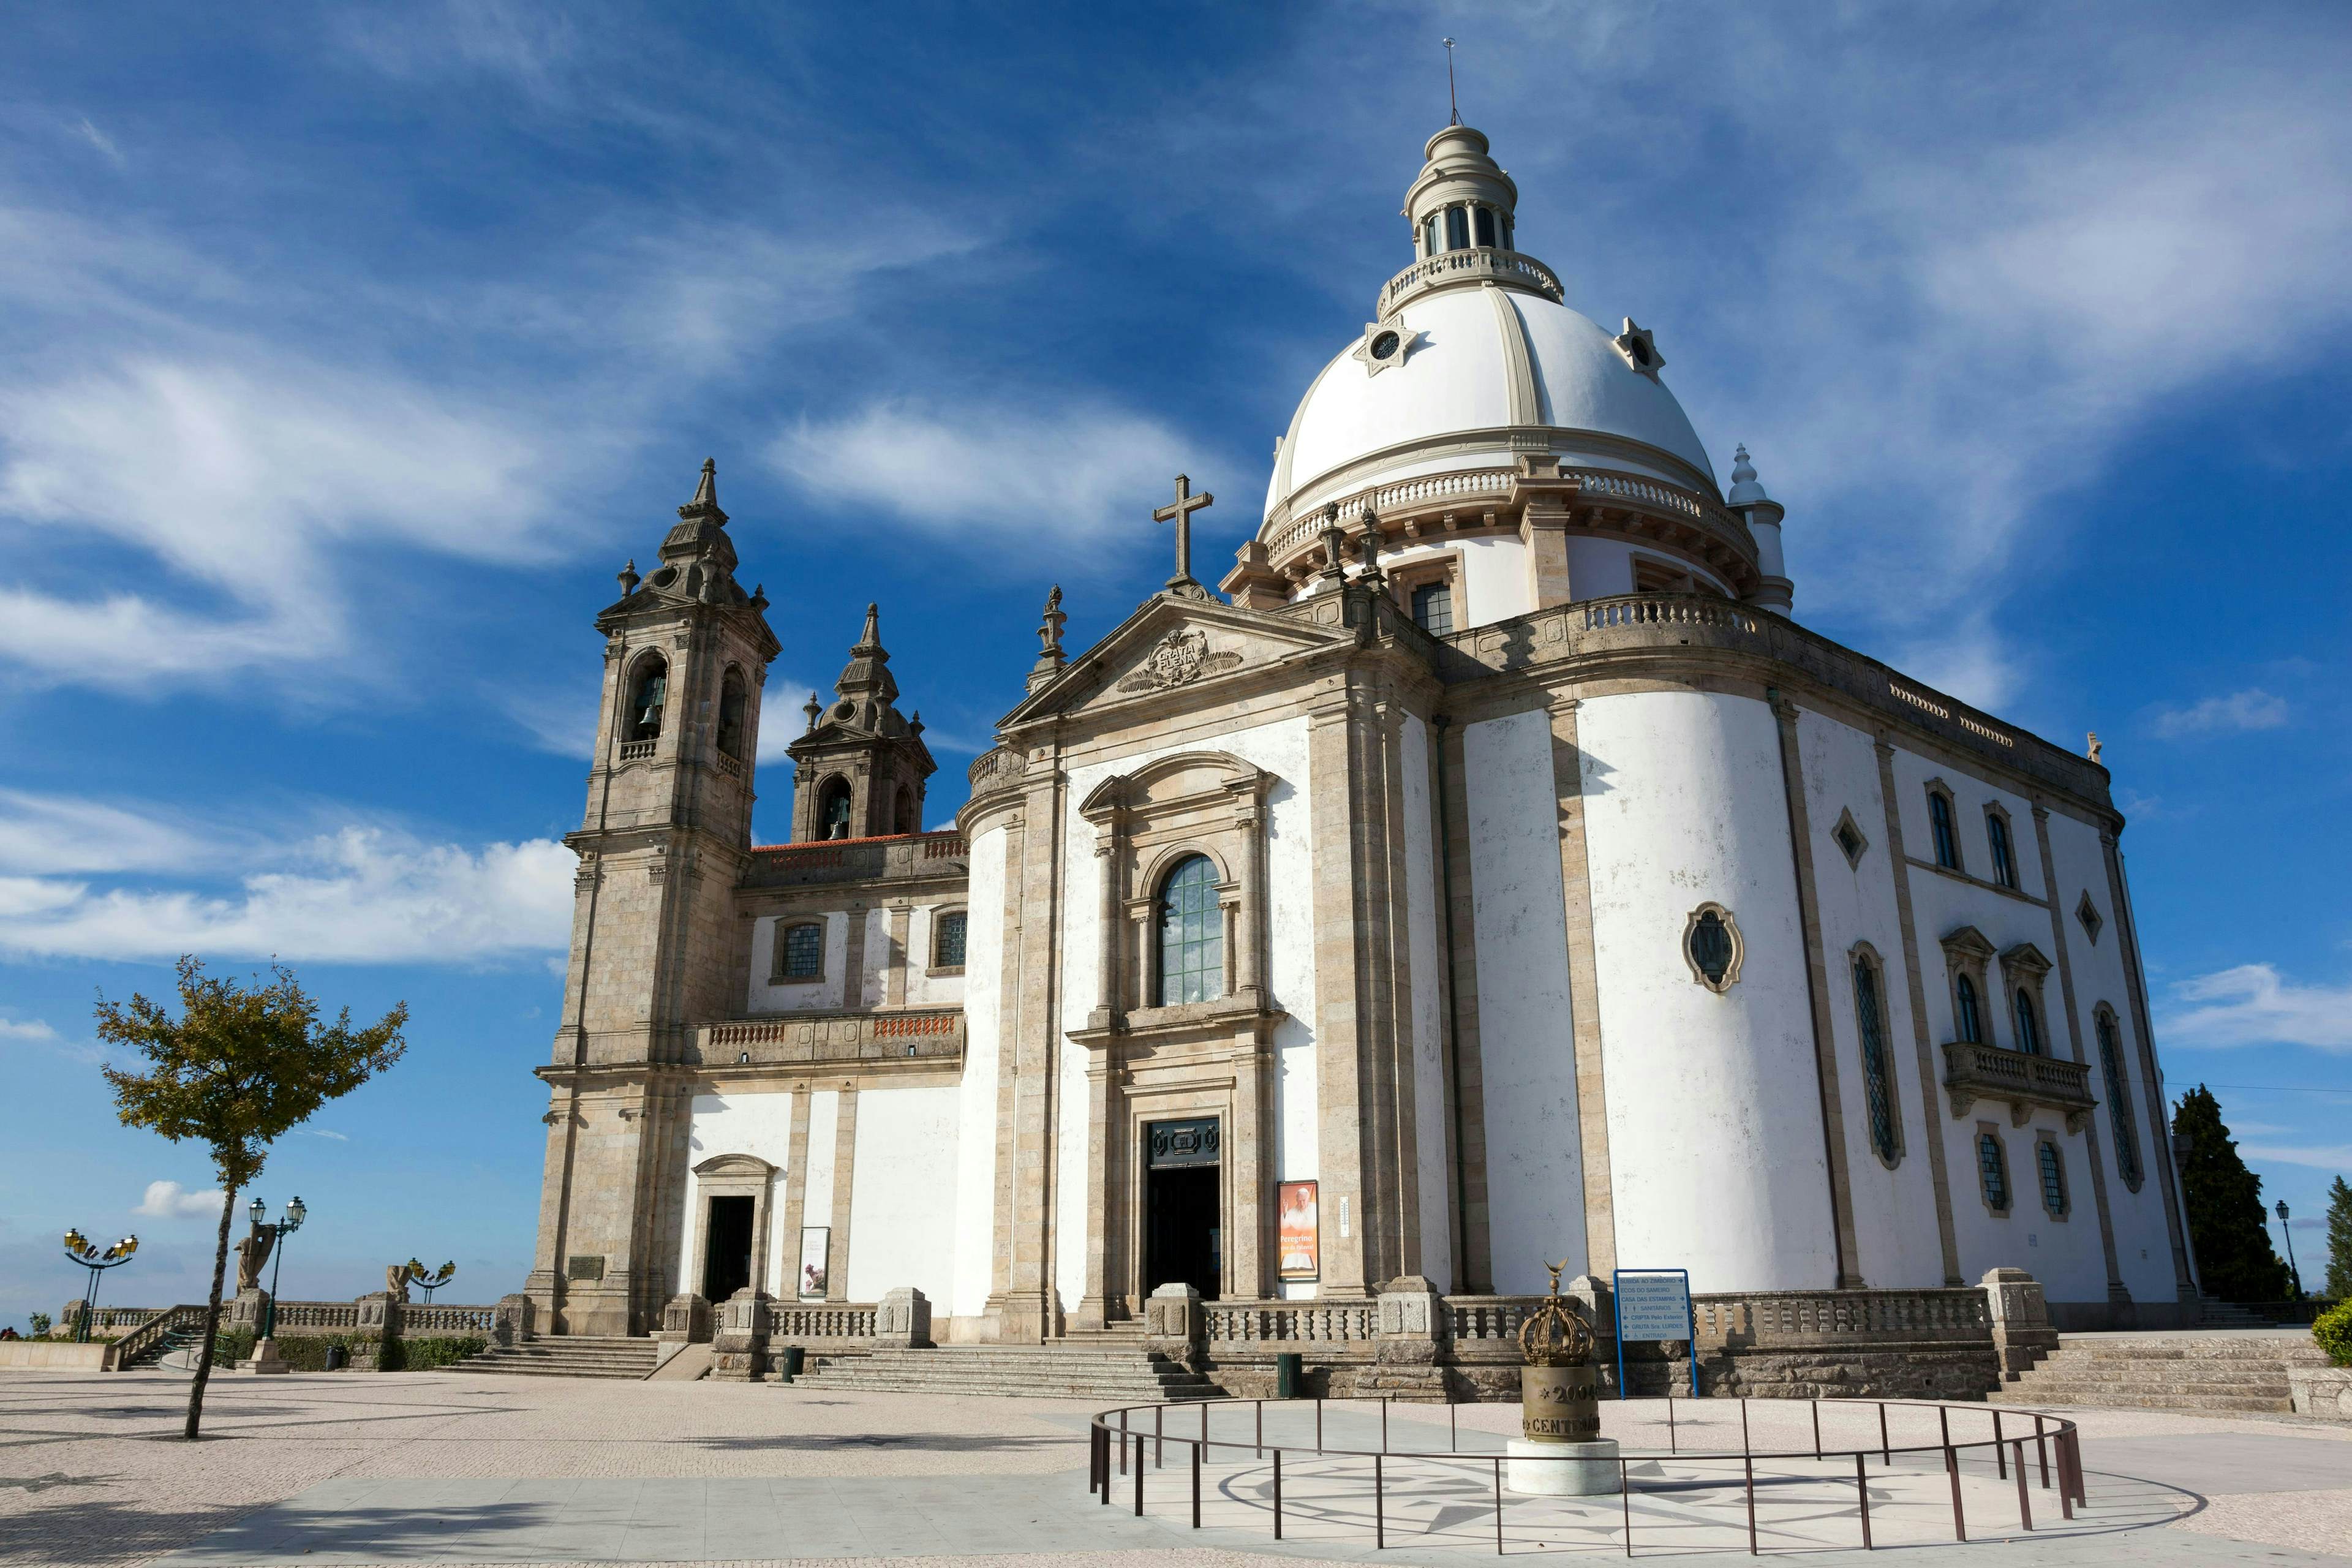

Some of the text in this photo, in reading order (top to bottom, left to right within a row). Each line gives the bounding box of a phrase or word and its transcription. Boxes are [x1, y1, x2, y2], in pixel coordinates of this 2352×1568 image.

[1160, 645, 1195, 661] GRATIA
[1159, 654, 1195, 671] PLENA
[1281, 1235, 1313, 1244] Peregrino
[1553, 1384, 1598, 1403] 2004
